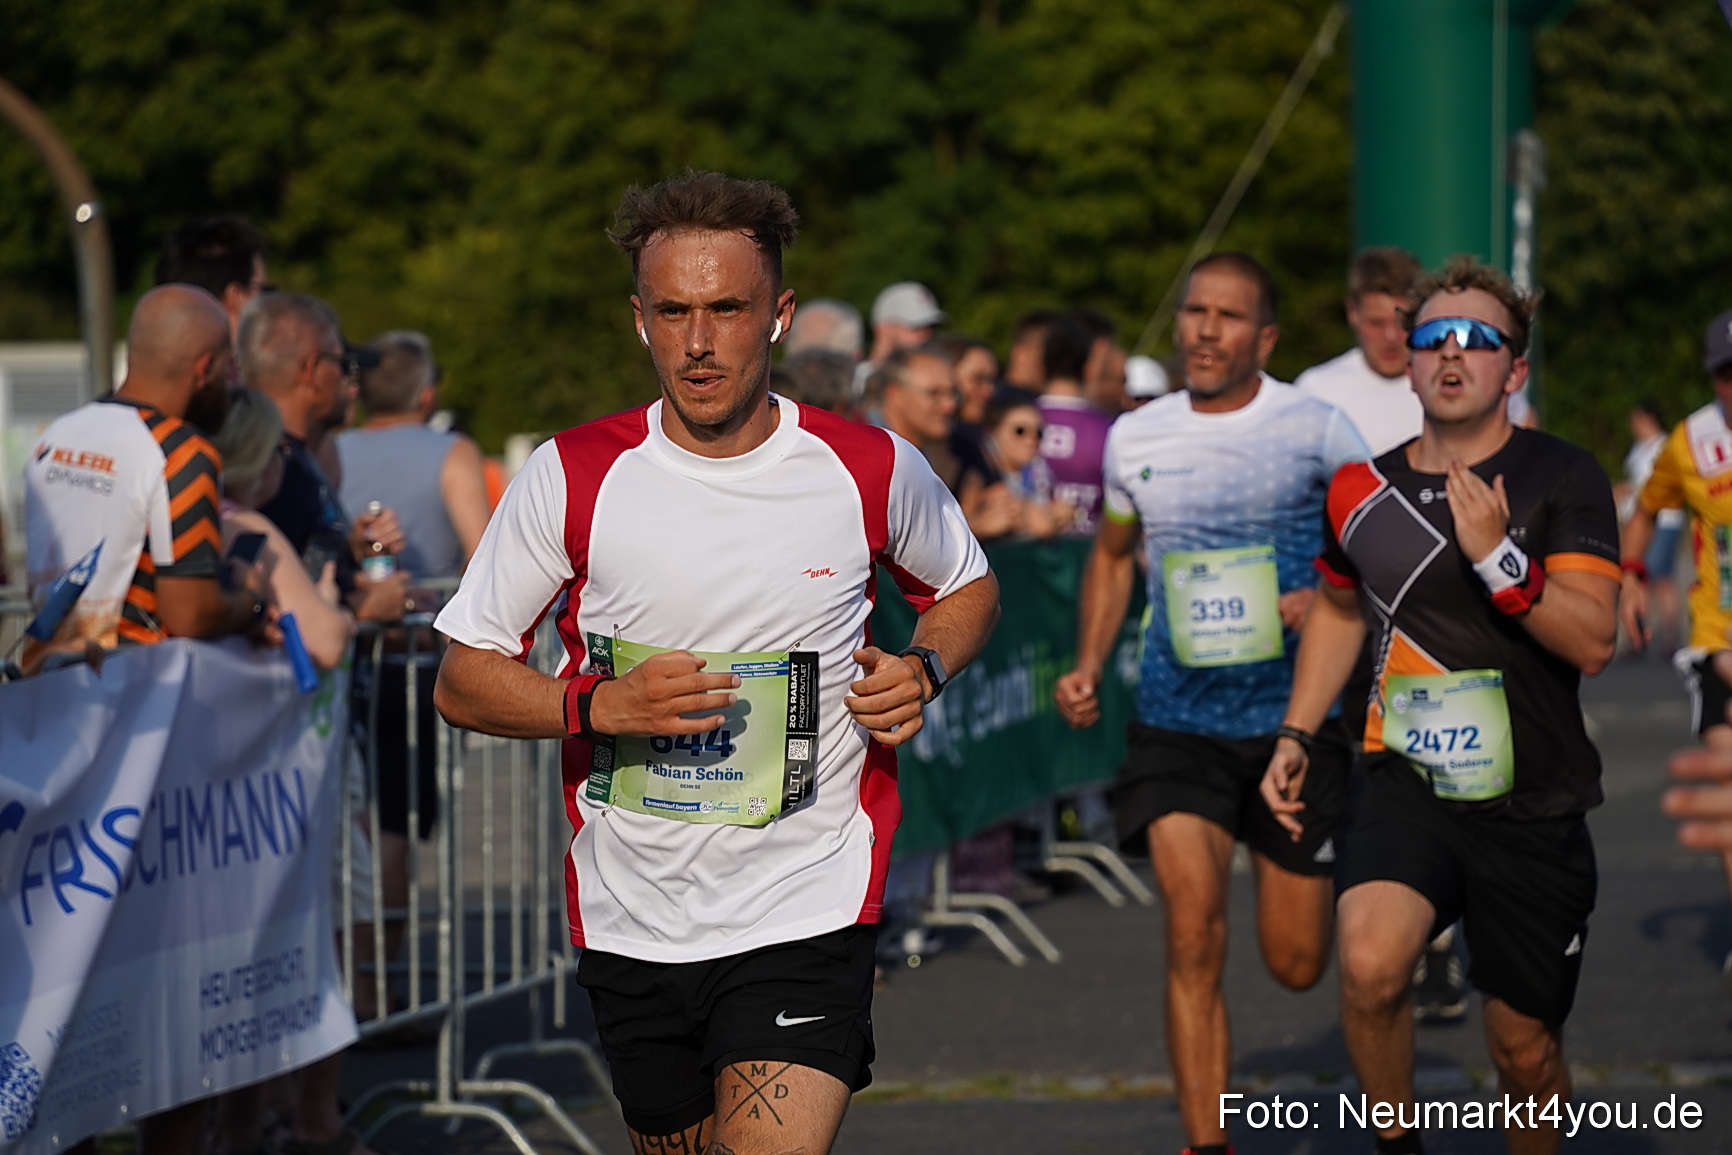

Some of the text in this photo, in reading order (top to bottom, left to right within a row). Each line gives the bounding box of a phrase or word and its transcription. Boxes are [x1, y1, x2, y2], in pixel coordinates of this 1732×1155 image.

[52, 446, 118, 477] KLEBL
[45, 466, 116, 497] DYNAMICS
[810, 567, 831, 579] DEHN
[1190, 597, 1245, 622] 339
[591, 646, 610, 658] AOK
[789, 662, 798, 729] 20 % RABATT
[1406, 726, 1482, 754] 2472
[645, 759, 744, 781] Fabian Schön
[645, 799, 698, 812] firmenlauf.bayern
[20, 769, 310, 926] FRISCHMANN
[199, 966, 254, 1011] HEUTE
[199, 1016, 263, 1066] MORGEN
[750, 1063, 767, 1077] M
[774, 1084, 789, 1099] D
[747, 1104, 761, 1119] A
